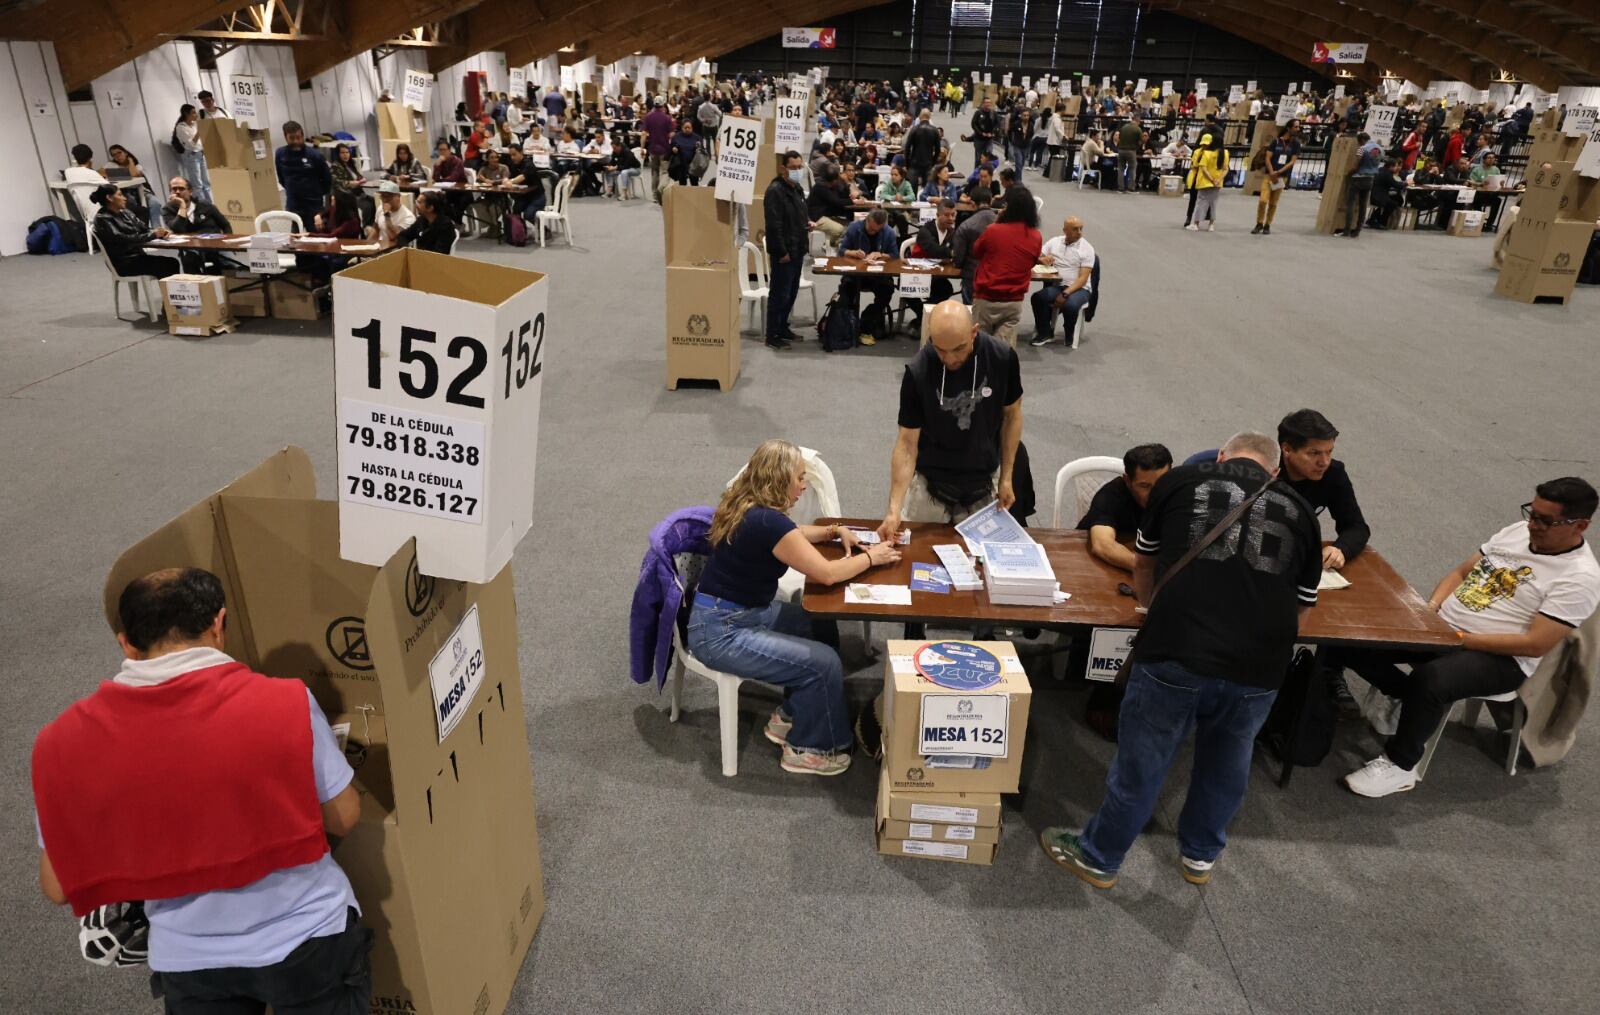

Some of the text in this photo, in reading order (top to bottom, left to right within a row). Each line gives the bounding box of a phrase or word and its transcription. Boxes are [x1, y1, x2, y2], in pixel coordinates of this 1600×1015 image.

[786, 36, 810, 44] Salida
[1338, 51, 1363, 60] Salida
[231, 81, 252, 96] 163
[408, 74, 425, 88] 169
[778, 104, 801, 119] 164
[1378, 110, 1396, 121] 171
[1582, 109, 1597, 119] 178
[723, 125, 757, 151] 158
[1589, 129, 1600, 143] 16
[351, 318, 488, 409] 152
[501, 312, 545, 400] 152
[371, 411, 454, 437] DE LA CÉDULA
[345, 423, 480, 466] 79.818.338
[361, 462, 463, 490] HASTA LA CÉDULA
[347, 475, 478, 516] 79.826.127
[1092, 656, 1123, 671] MES
[440, 675, 466, 722] MESA
[465, 648, 482, 683] 152
[924, 726, 1004, 744] MESA 152
